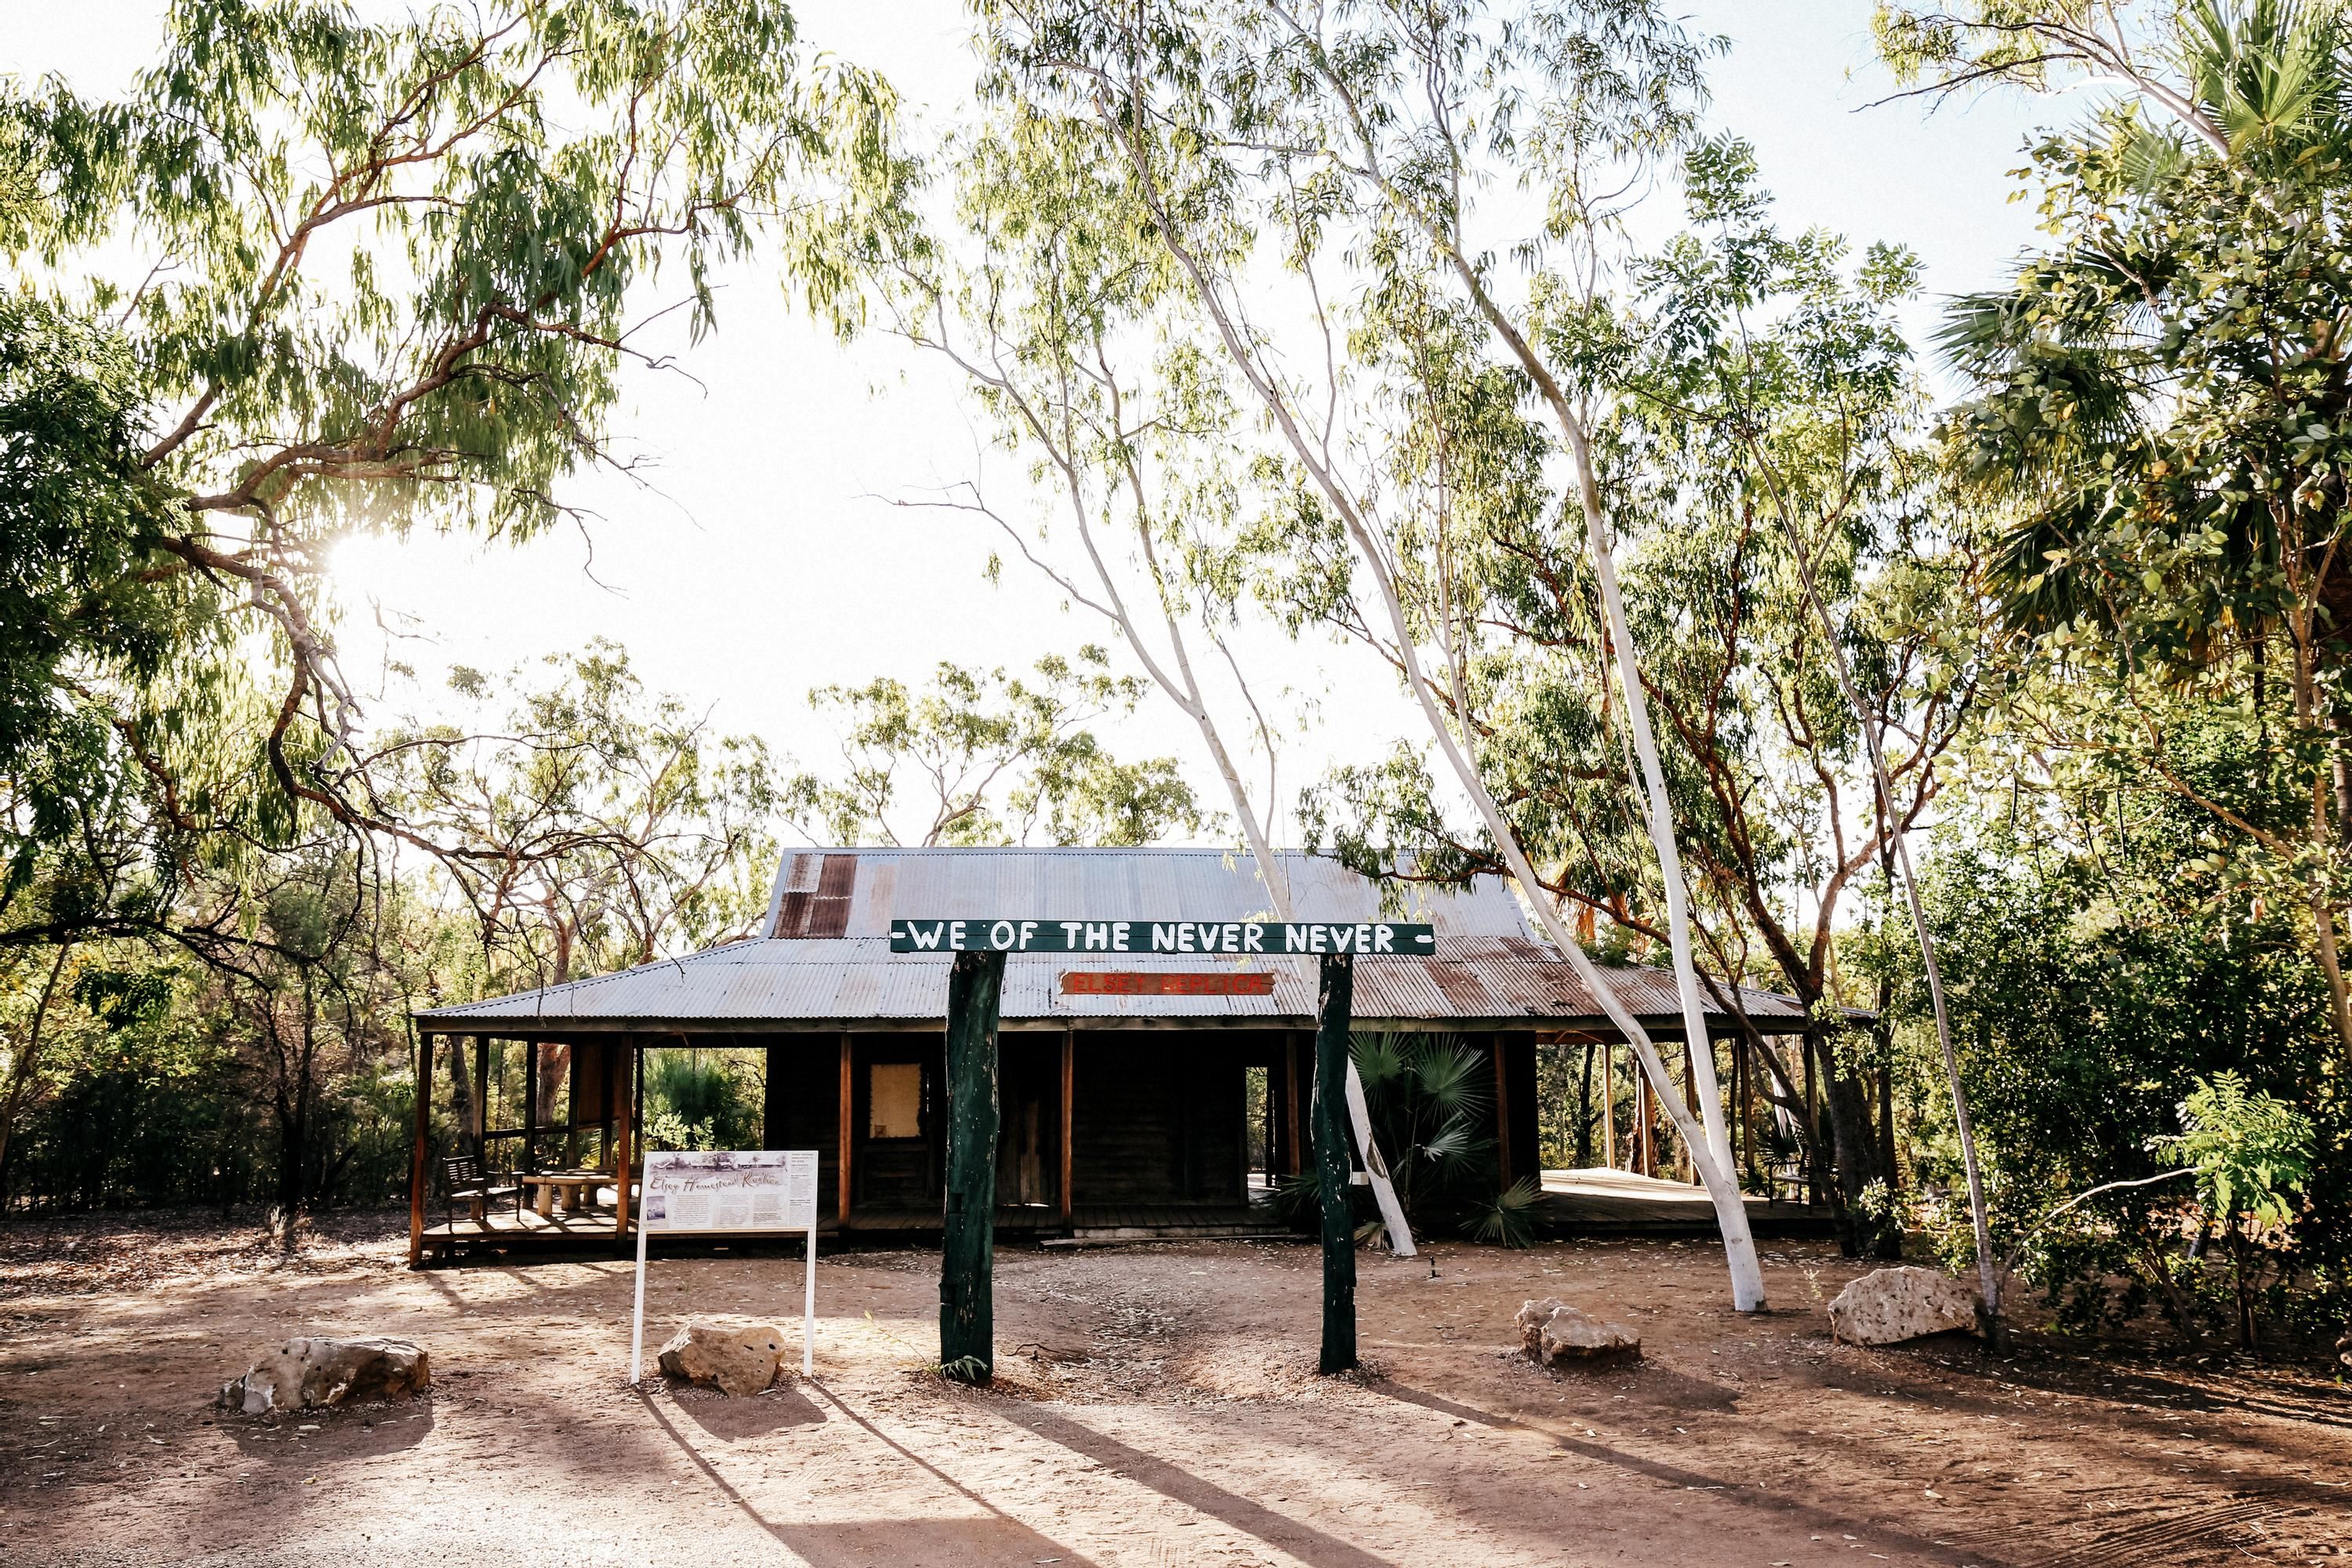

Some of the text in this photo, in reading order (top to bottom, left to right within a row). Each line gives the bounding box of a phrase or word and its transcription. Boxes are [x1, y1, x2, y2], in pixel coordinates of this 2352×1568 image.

[990, 920, 1038, 950] OF
[1060, 922, 1131, 951] THE
[1152, 923, 1264, 953] NEVER
[1285, 924, 1395, 953] NEVER
[1073, 975, 1262, 993] ELSEY REPLICA
